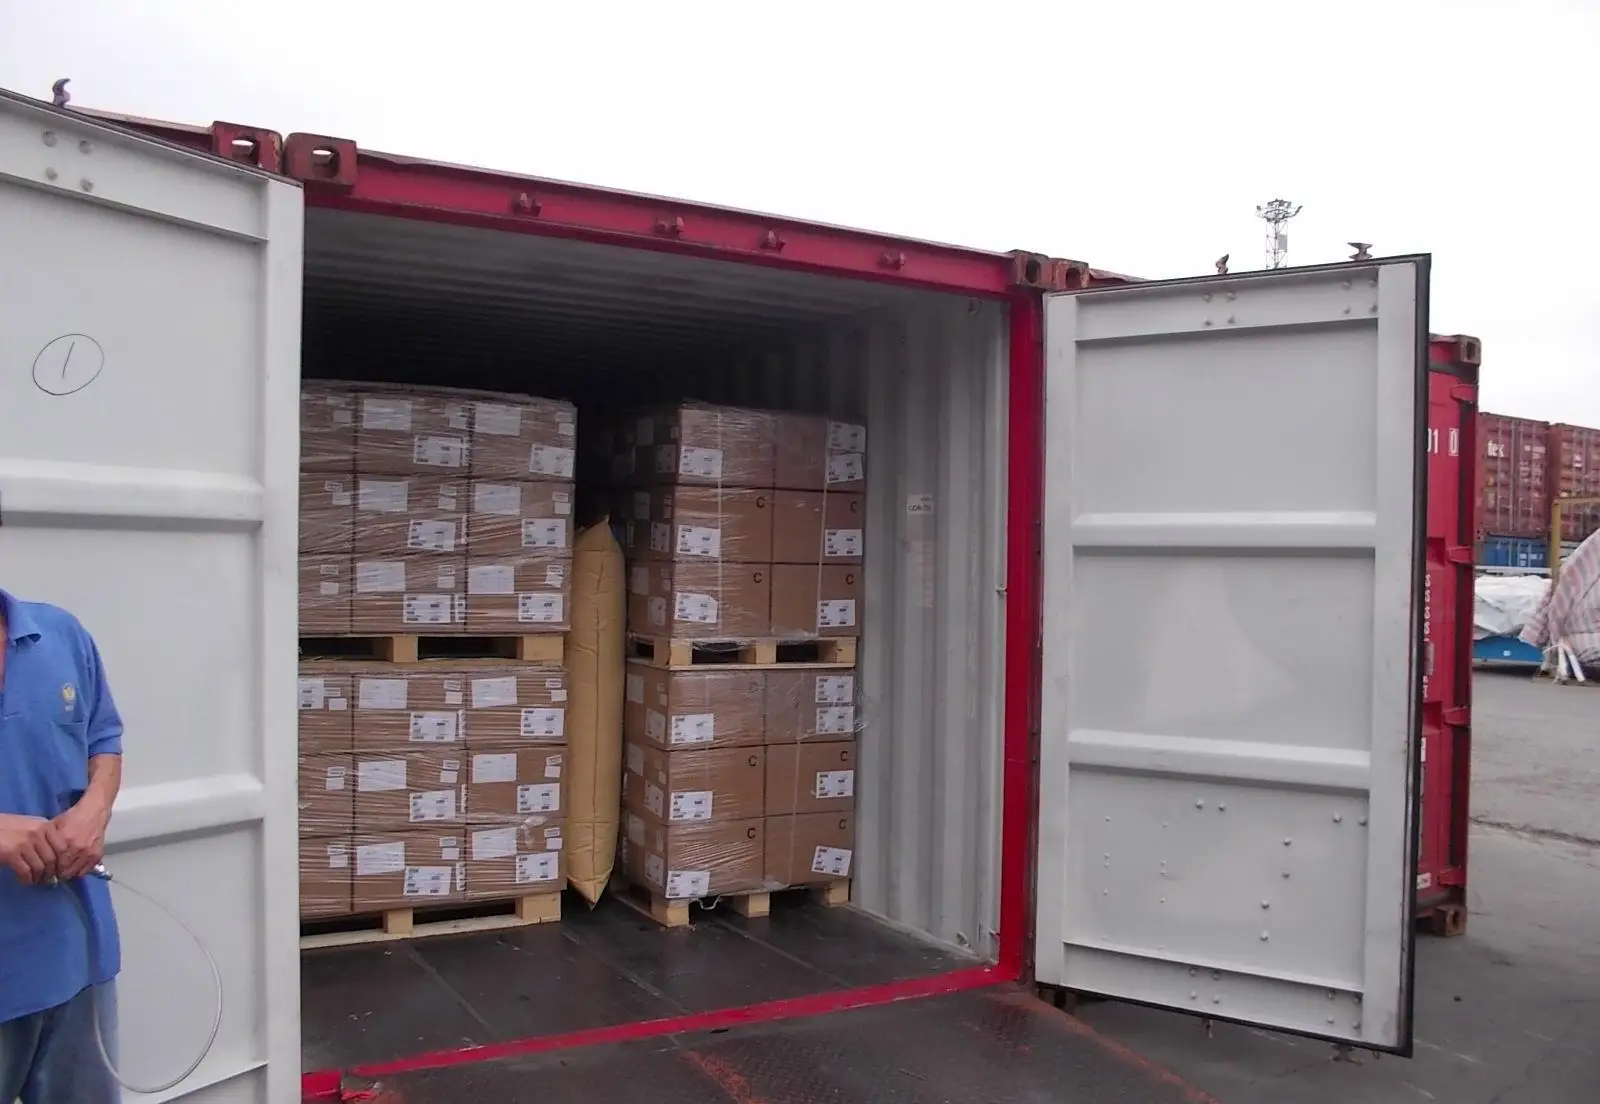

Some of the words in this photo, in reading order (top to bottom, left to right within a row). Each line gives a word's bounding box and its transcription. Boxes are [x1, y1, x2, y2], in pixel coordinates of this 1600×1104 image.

[1487, 439, 1505, 458] tex
[756, 496, 766, 508] C
[850, 501, 859, 513] C
[753, 572, 763, 584] C
[845, 574, 855, 585] C
[748, 755, 758, 767] C
[840, 751, 849, 762] C
[838, 819, 847, 830] C
[747, 828, 756, 839] C
